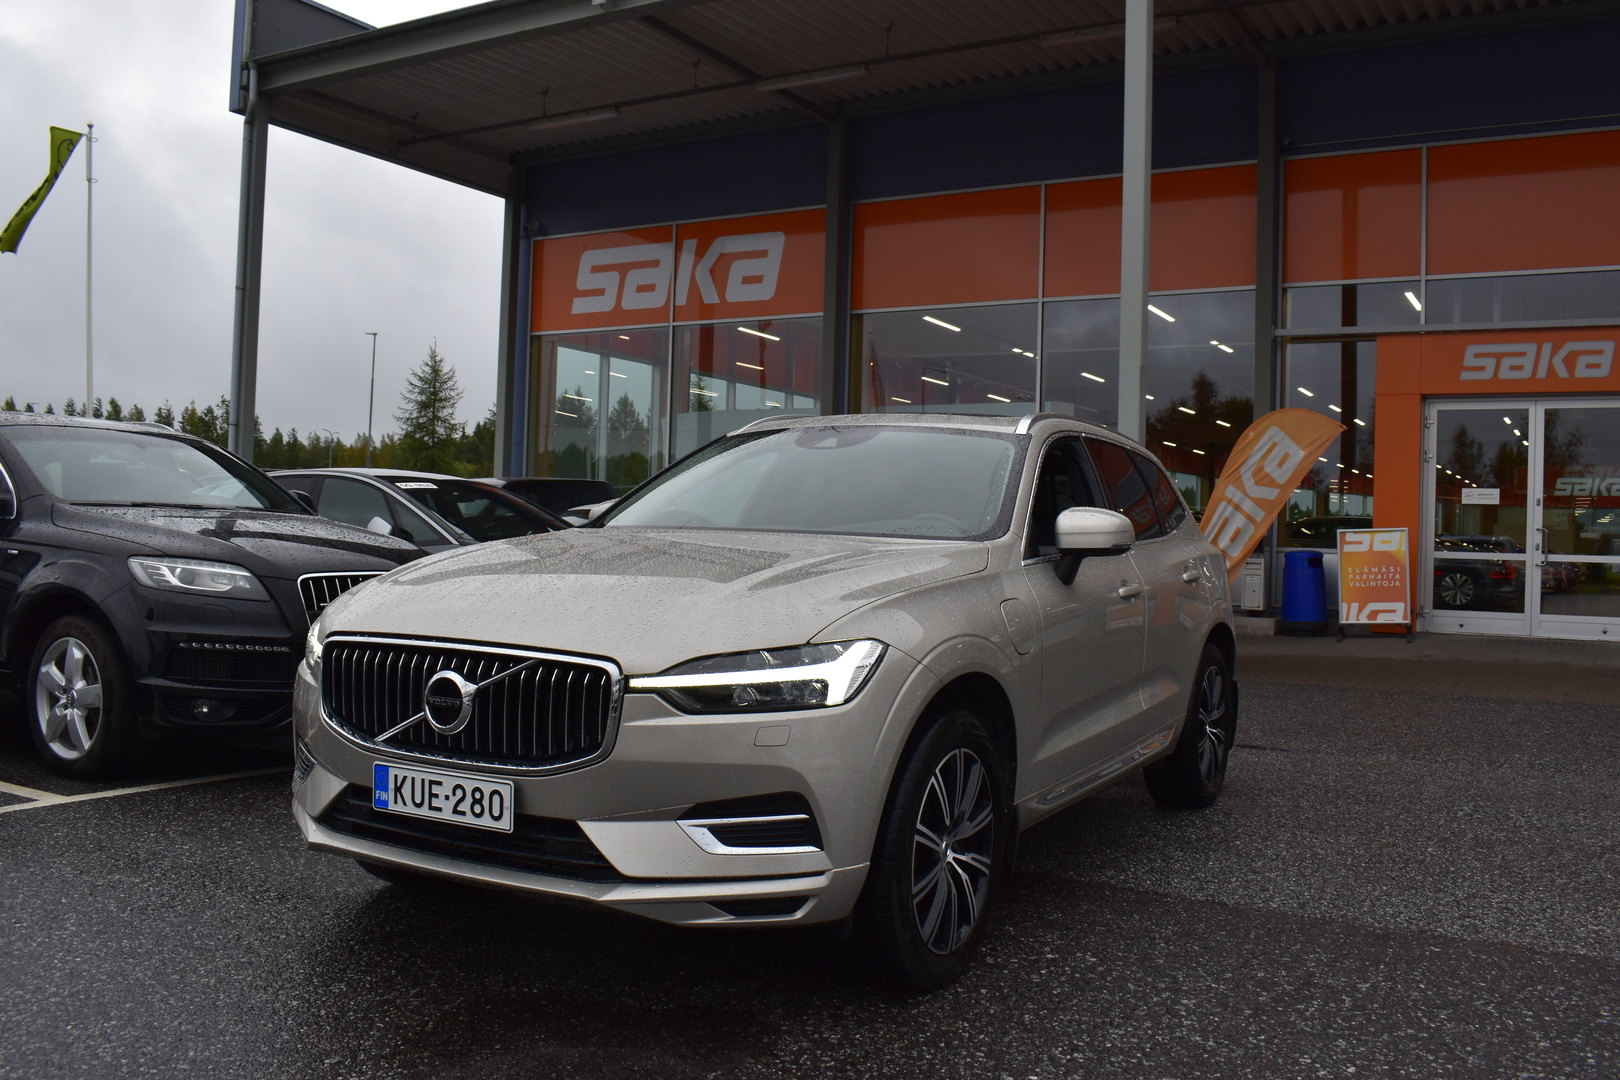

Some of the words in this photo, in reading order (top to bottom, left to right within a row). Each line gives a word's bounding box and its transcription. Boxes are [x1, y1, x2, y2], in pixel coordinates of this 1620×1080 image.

[1348, 565, 1400, 573] ELÄMÄSI
[63, 620, 99, 653] GENERAL
[427, 697, 461, 708] VOLVO
[375, 790, 388, 801] FIN
[393, 773, 504, 822] KUE-280
